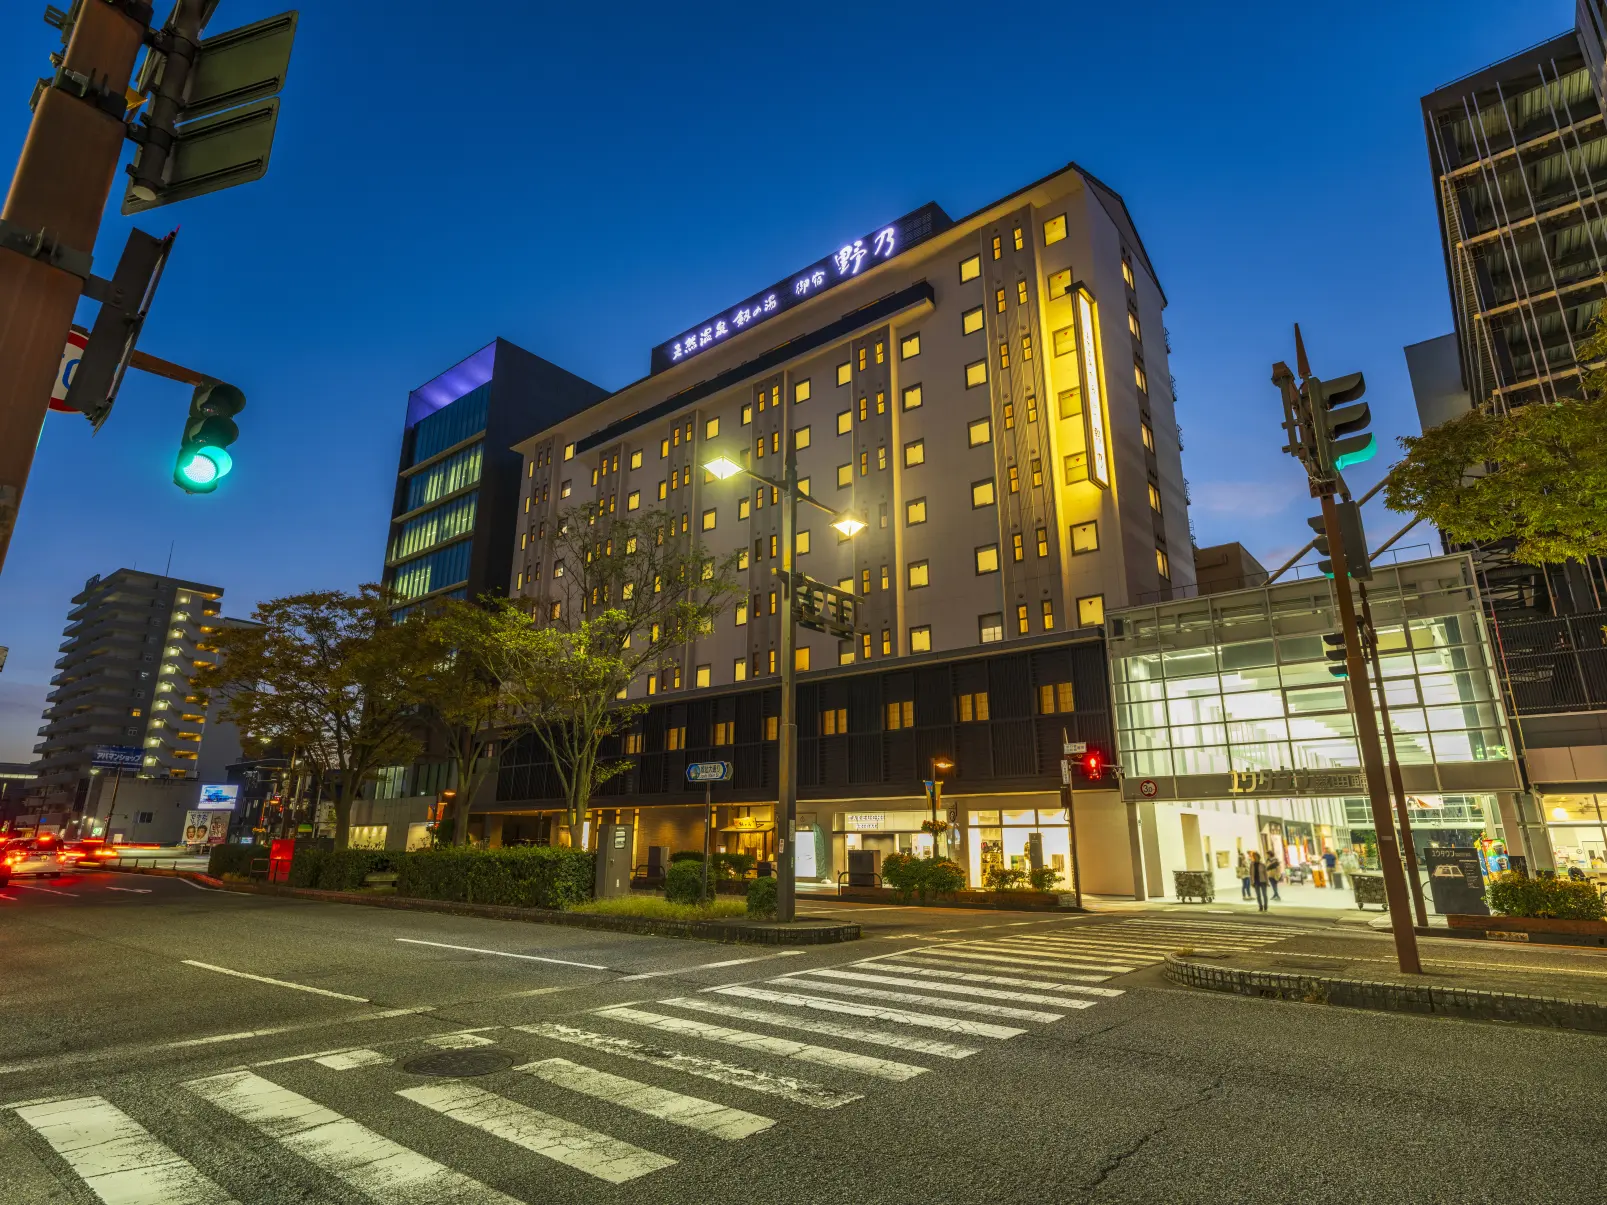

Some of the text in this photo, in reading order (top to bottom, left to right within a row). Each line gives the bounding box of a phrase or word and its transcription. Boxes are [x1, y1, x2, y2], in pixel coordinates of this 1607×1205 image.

[97, 752, 141, 761] アパマンショップ
[1228, 766, 1309, 793] ユウタウン
